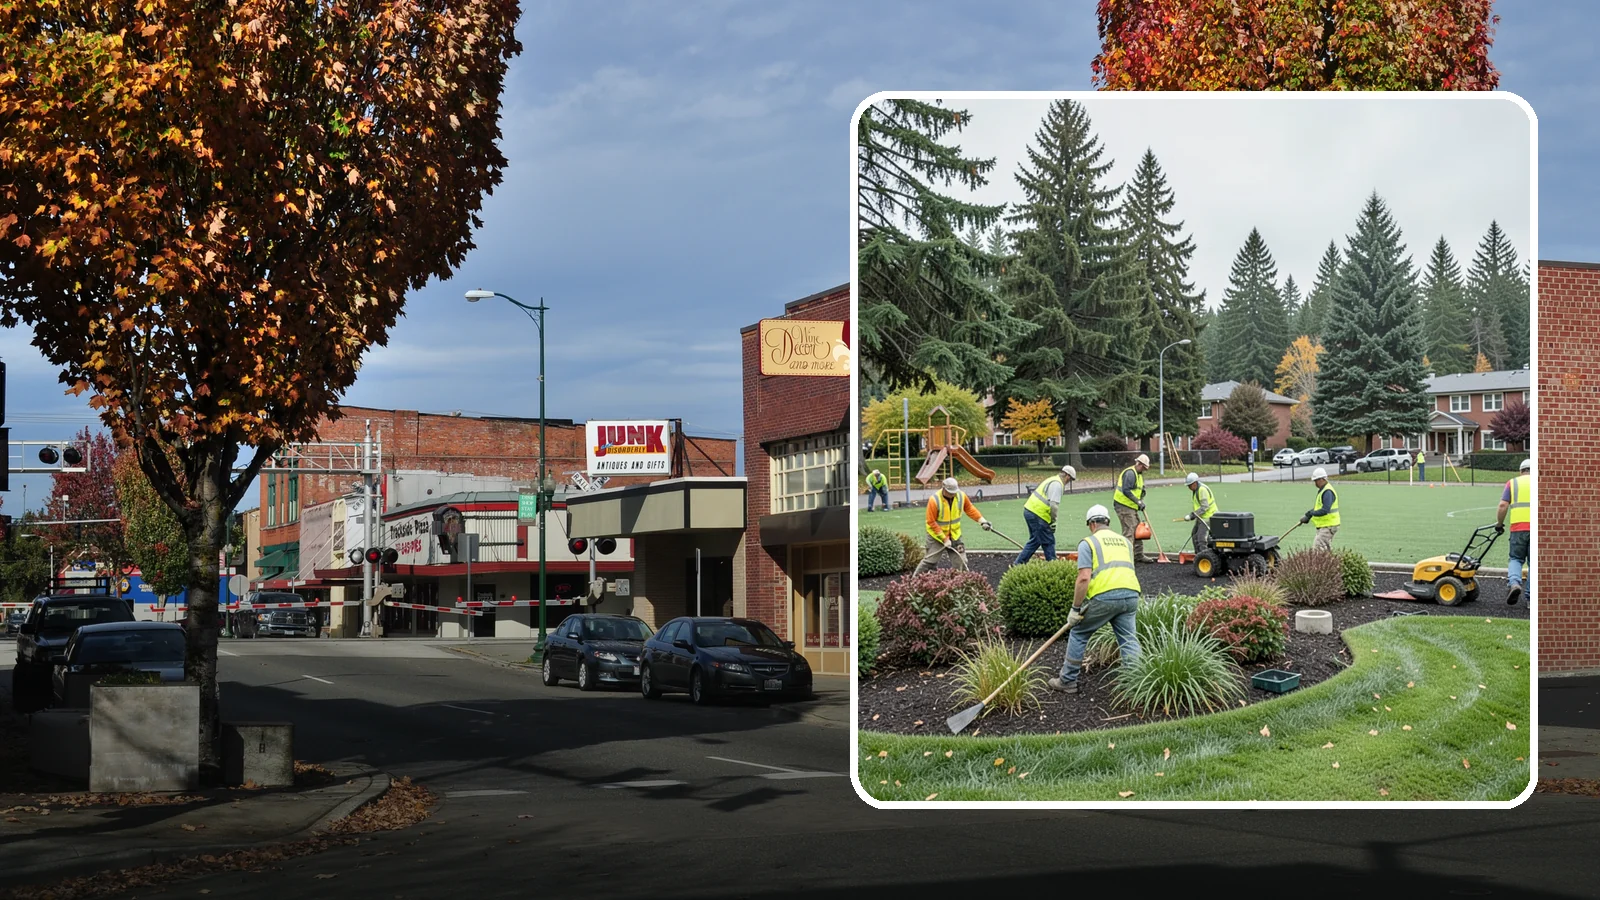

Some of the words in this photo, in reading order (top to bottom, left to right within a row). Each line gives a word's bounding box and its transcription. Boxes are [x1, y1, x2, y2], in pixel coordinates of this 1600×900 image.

[791, 325, 824, 345] Wine
[765, 328, 831, 365] Decor
[596, 425, 665, 457] JUNK
[607, 446, 646, 454] DISORDERLY
[597, 461, 628, 470] ANTIQUES
[631, 461, 643, 470] AND
[647, 460, 665, 469] GIFTS
[390, 521, 413, 540] Trackside
[414, 519, 429, 535] Pizza
